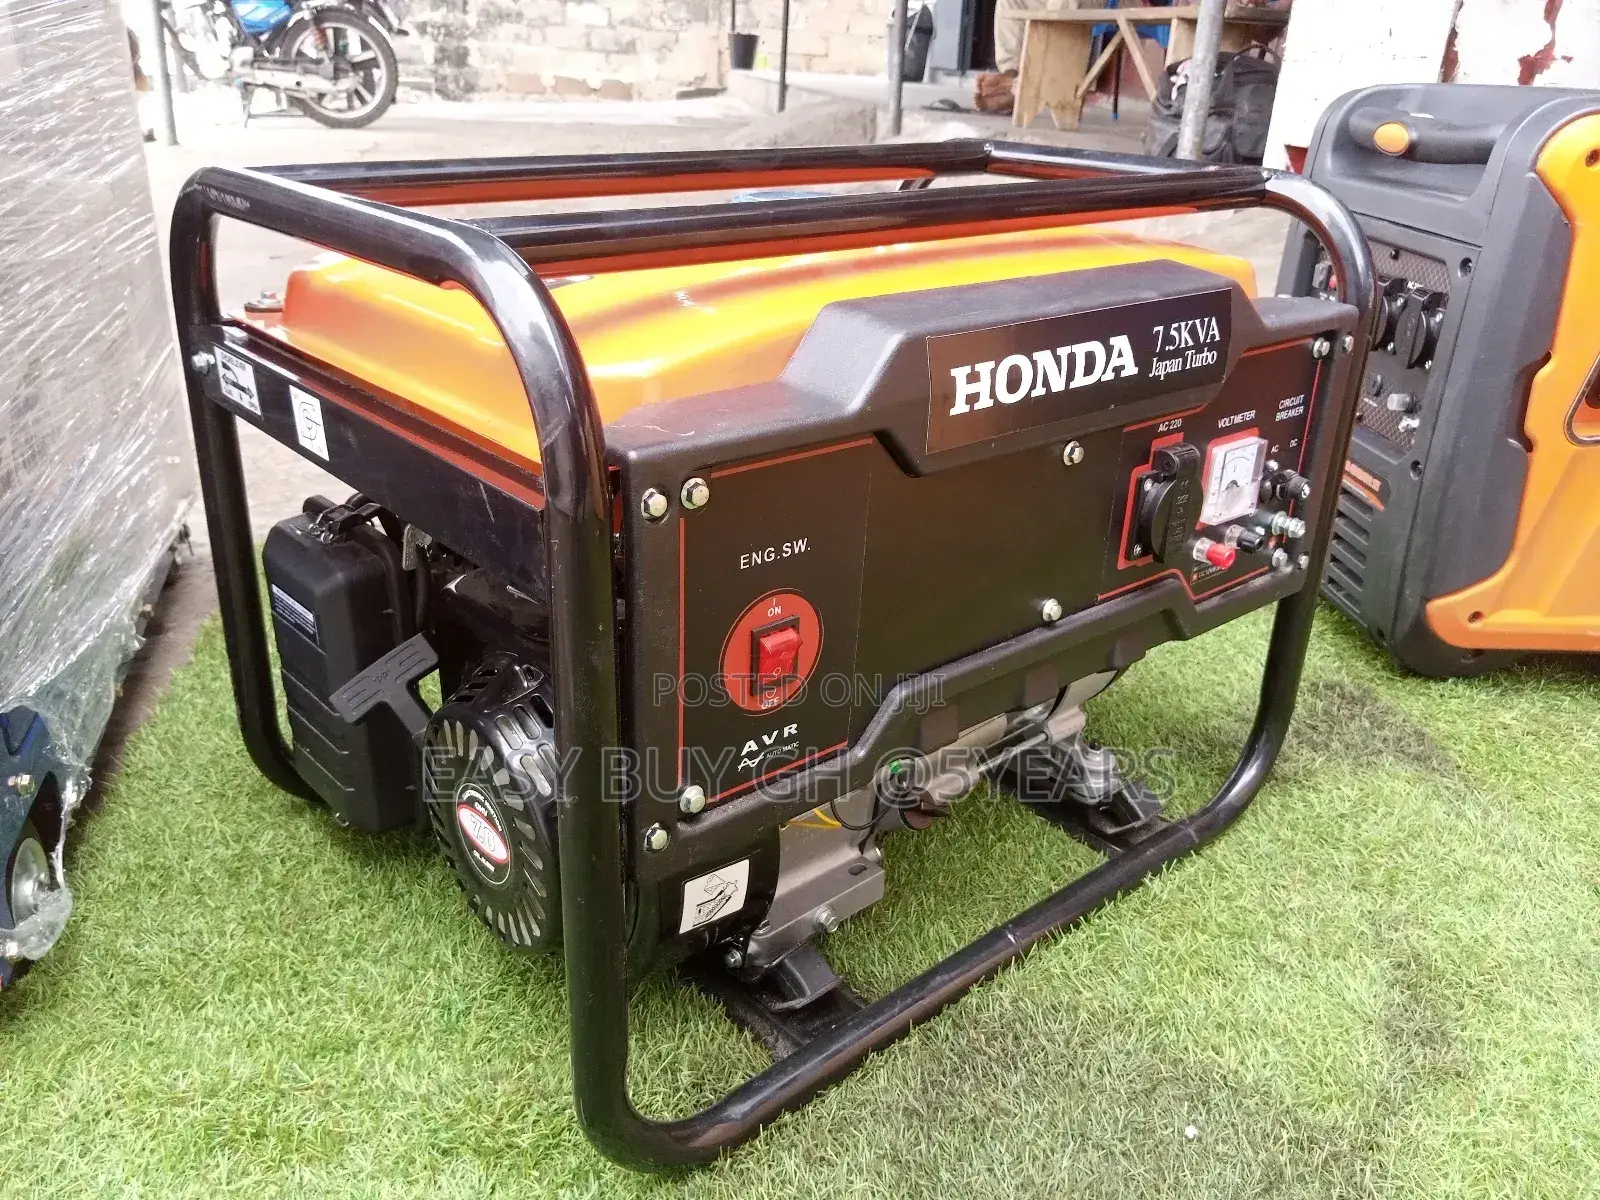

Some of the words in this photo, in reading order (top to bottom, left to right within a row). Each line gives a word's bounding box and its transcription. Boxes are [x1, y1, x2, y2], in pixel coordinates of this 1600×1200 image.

[1152, 316, 1220, 353] 7.5KVA
[1149, 356, 1182, 380] Japan
[1184, 347, 1217, 371] Turbo
[949, 334, 1139, 416] HONDA
[1278, 394, 1305, 410] CIRCUIT
[1217, 410, 1256, 428] VOLTMETER
[1275, 406, 1304, 422] BREAKER
[1157, 421, 1169, 433] AC
[1169, 419, 1182, 430] 220
[1271, 444, 1279, 454] AC
[1290, 438, 1298, 448] DC
[740, 537, 811, 569] ENG.SW.
[767, 605, 782, 617] ON
[761, 696, 780, 710] OFF
[741, 723, 798, 756] AVR
